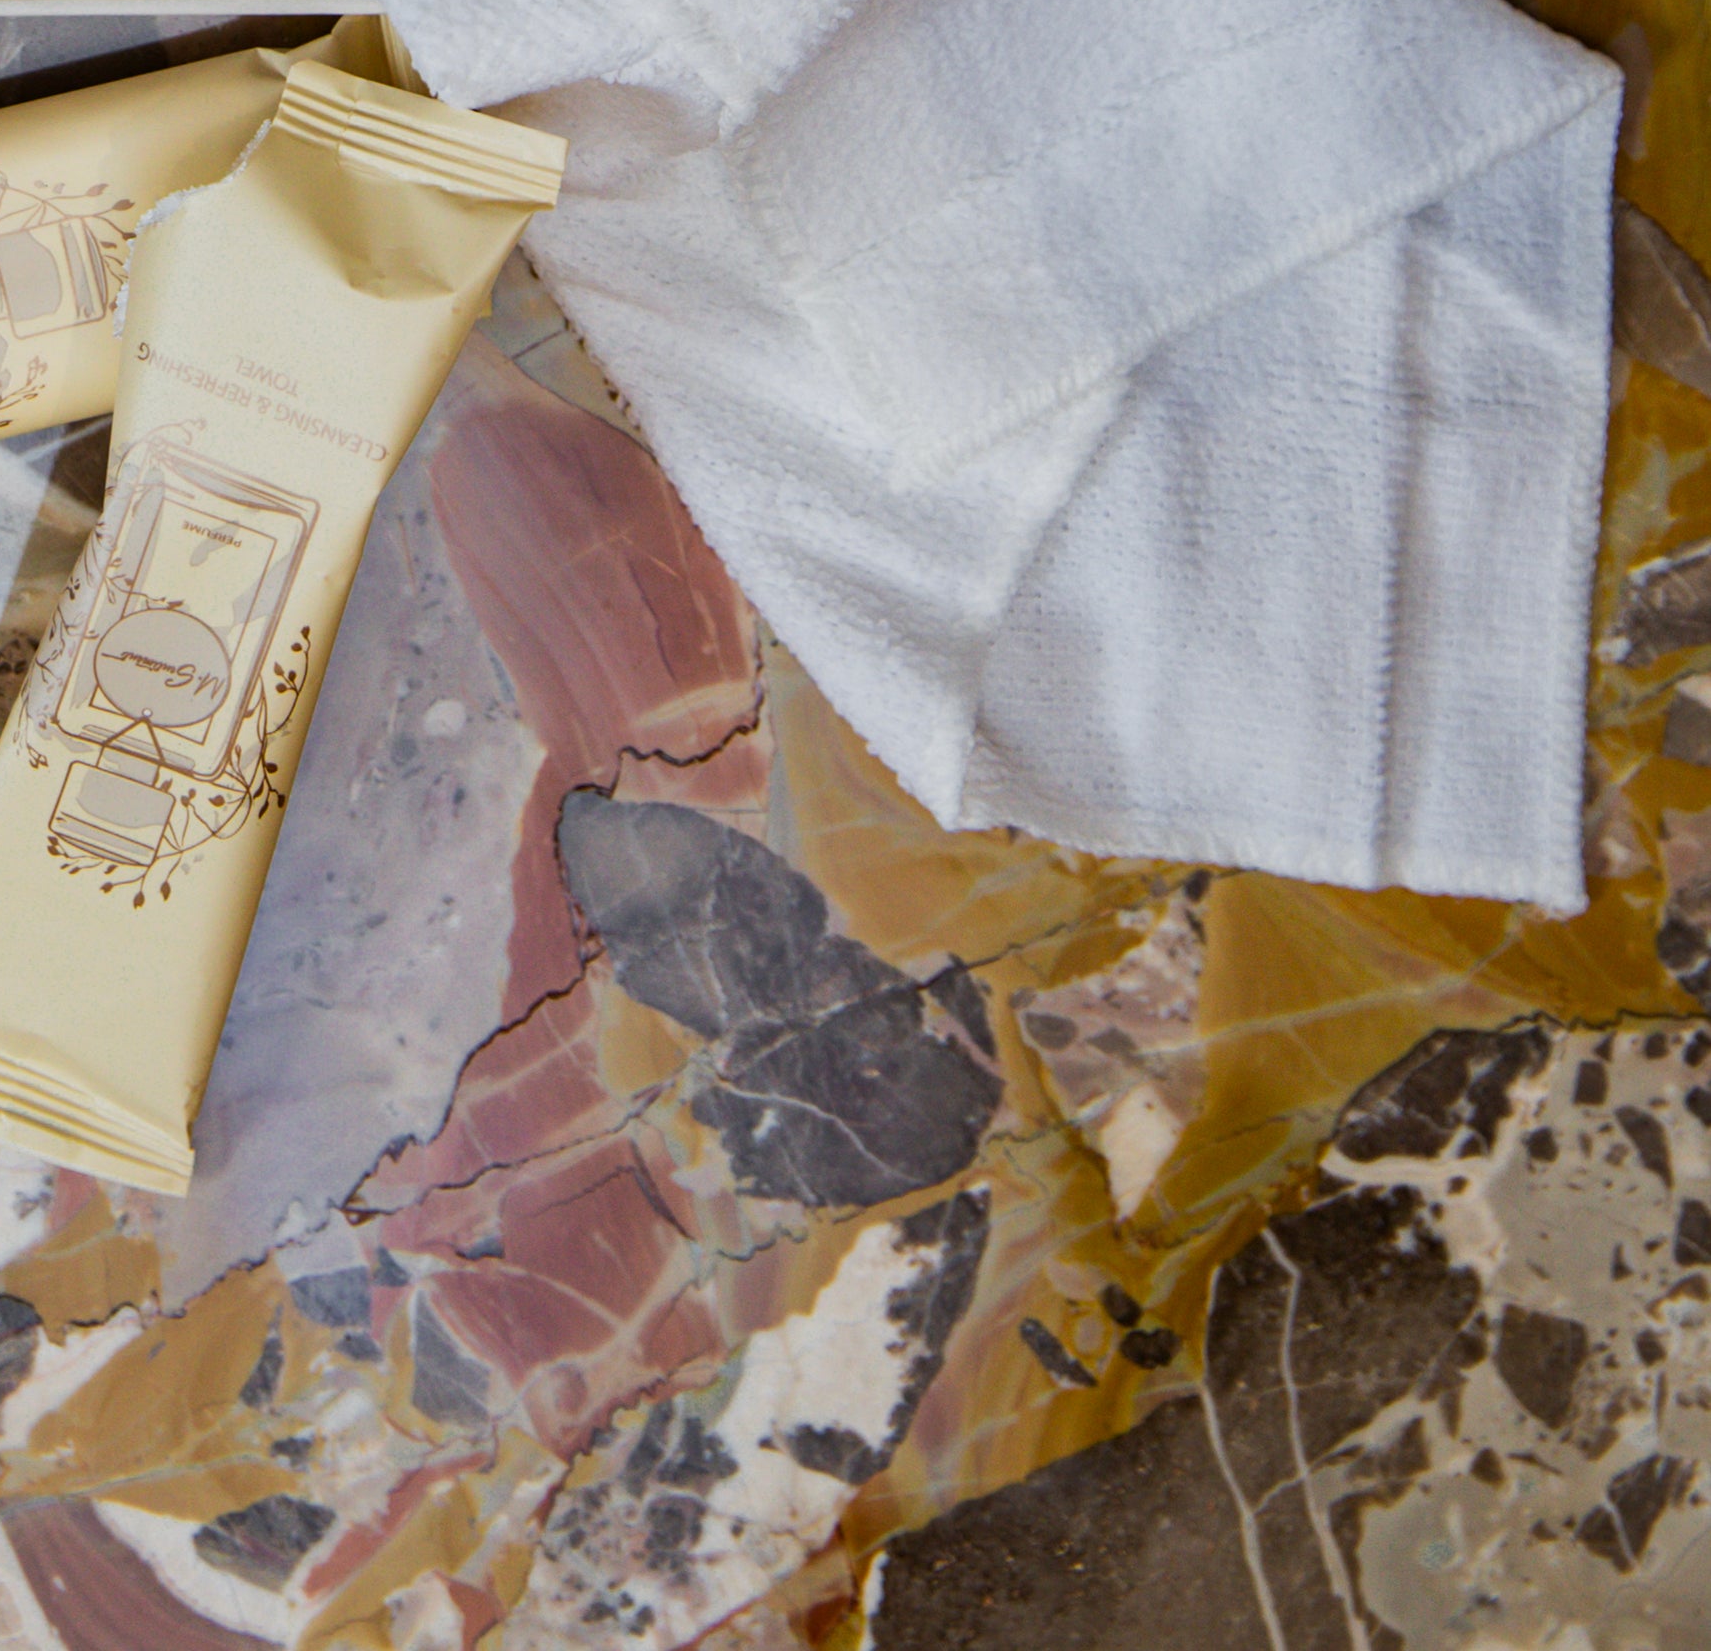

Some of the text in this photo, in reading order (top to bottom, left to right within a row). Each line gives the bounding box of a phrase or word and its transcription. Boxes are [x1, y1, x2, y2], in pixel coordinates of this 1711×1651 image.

[234, 356, 298, 397] TOWEL
[137, 342, 387, 462] CLEANSING & REFRESHING
[183, 519, 242, 548] PERFUME
